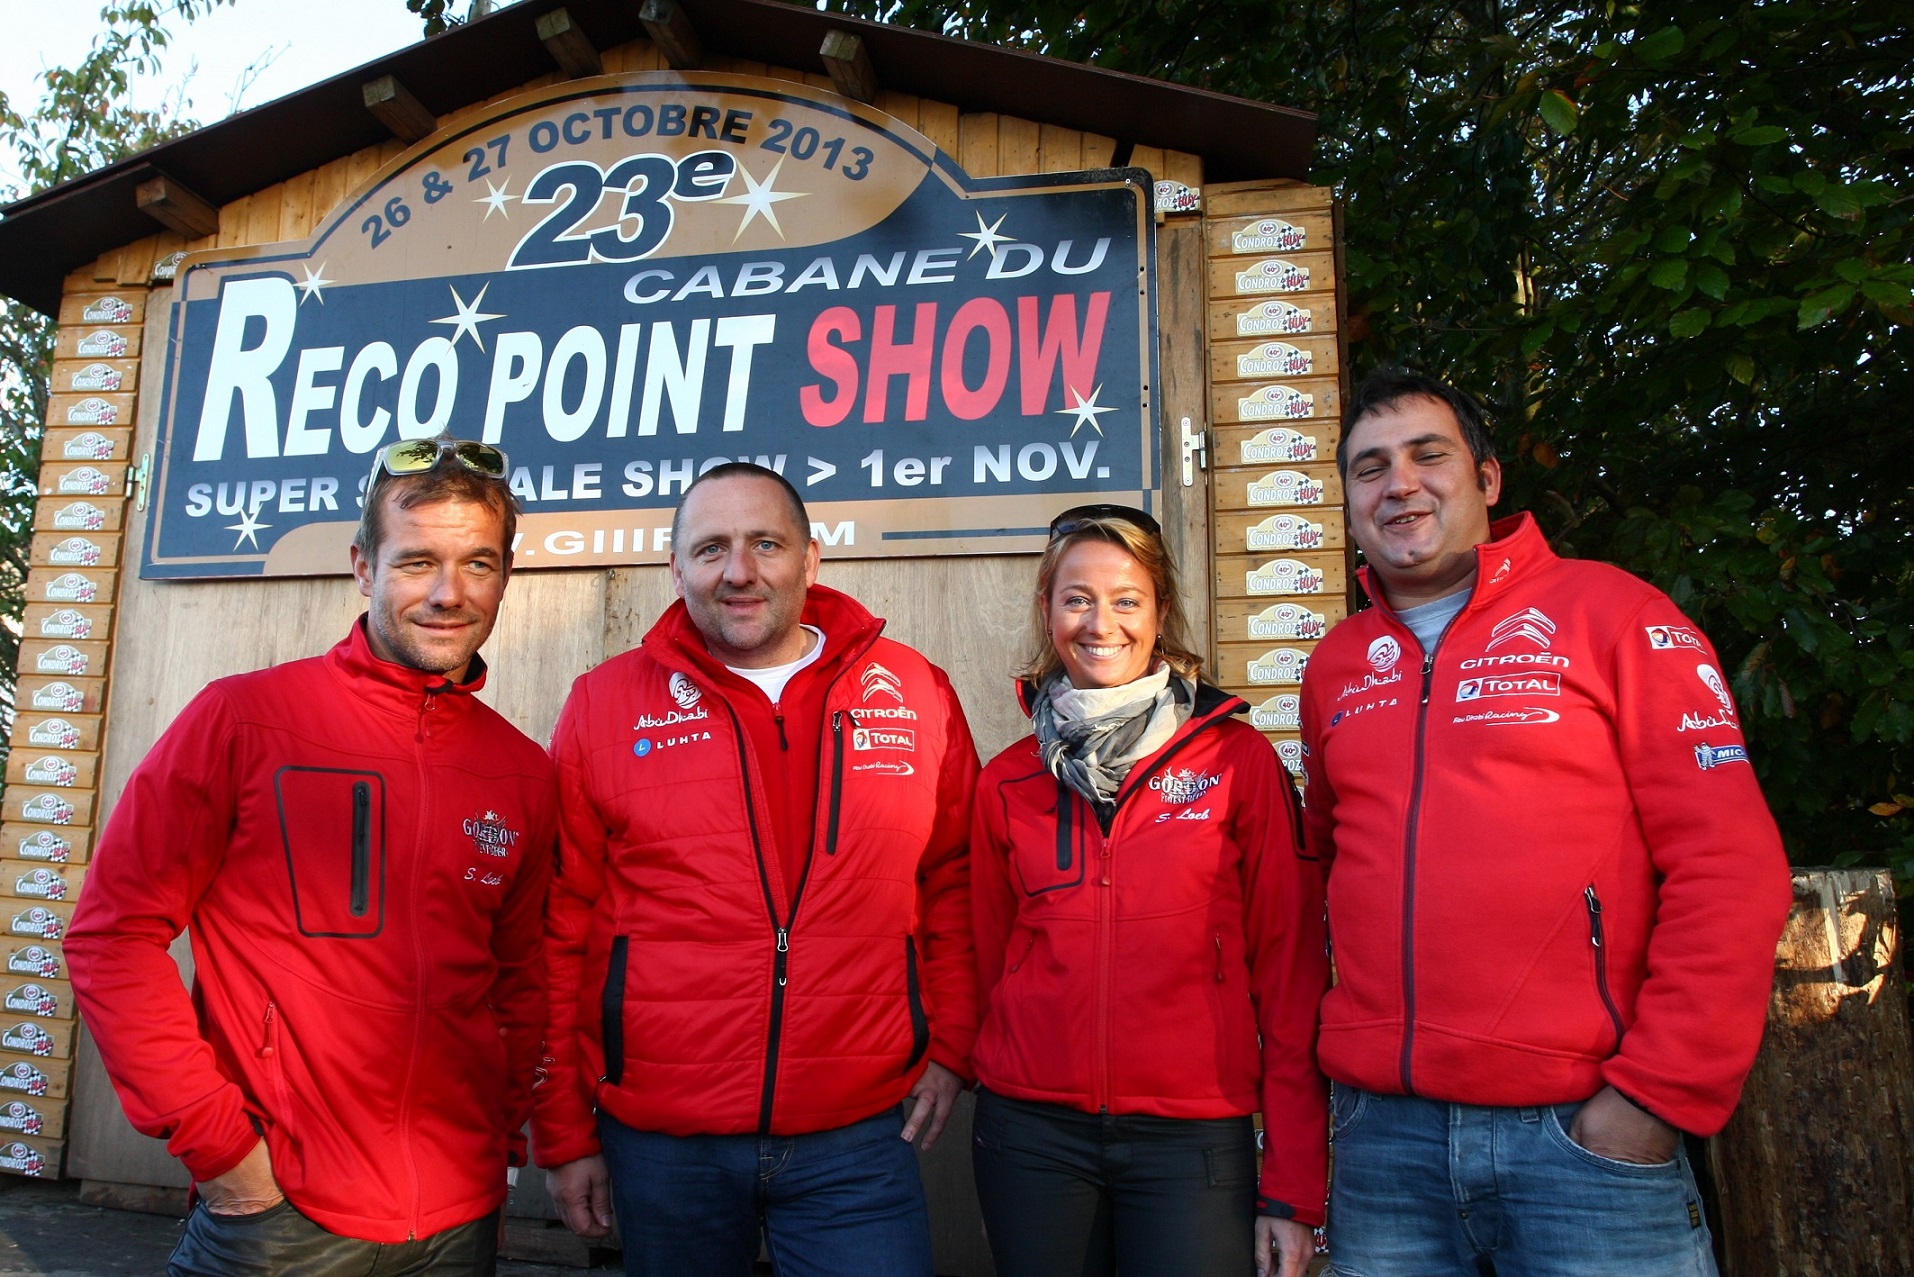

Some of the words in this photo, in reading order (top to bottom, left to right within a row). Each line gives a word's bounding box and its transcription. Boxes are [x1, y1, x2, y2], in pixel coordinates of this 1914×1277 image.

[361, 195, 411, 249] 26
[421, 170, 454, 205] &
[462, 133, 512, 182] 27
[528, 103, 754, 154] OCTOBRE
[760, 117, 876, 181] 2013
[1234, 233, 1280, 249] CONDROZ
[623, 247, 963, 304] CABANE
[984, 237, 1112, 280] DU
[1238, 275, 1282, 290] CONDROZ
[1240, 316, 1284, 331] CONDROZ
[193, 276, 459, 462] RECO
[481, 313, 777, 445] POINT
[800, 291, 1112, 428] SHOW
[1240, 358, 1285, 372] CONDROZ
[1241, 400, 1286, 416] CONDROZ
[1244, 443, 1288, 458] CONDROZ
[186, 476, 340, 518] SUPER
[861, 448, 953, 487] 1er
[973, 440, 1111, 483] NOV.
[1250, 485, 1296, 502] CONDROZ
[1250, 530, 1296, 546] CONDROZ
[1250, 575, 1296, 591] CONDROZ
[1251, 618, 1298, 634] CONDROZ
[1250, 664, 1297, 680] CONDROZ
[1484, 678, 1557, 692] TOTAL
[1345, 698, 1398, 718] LUHTA
[1252, 708, 1300, 726] CONDROZ
[656, 731, 711, 750] LUHTA
[870, 732, 913, 747] TOTAL
[1176, 808, 1211, 820] Loeb
